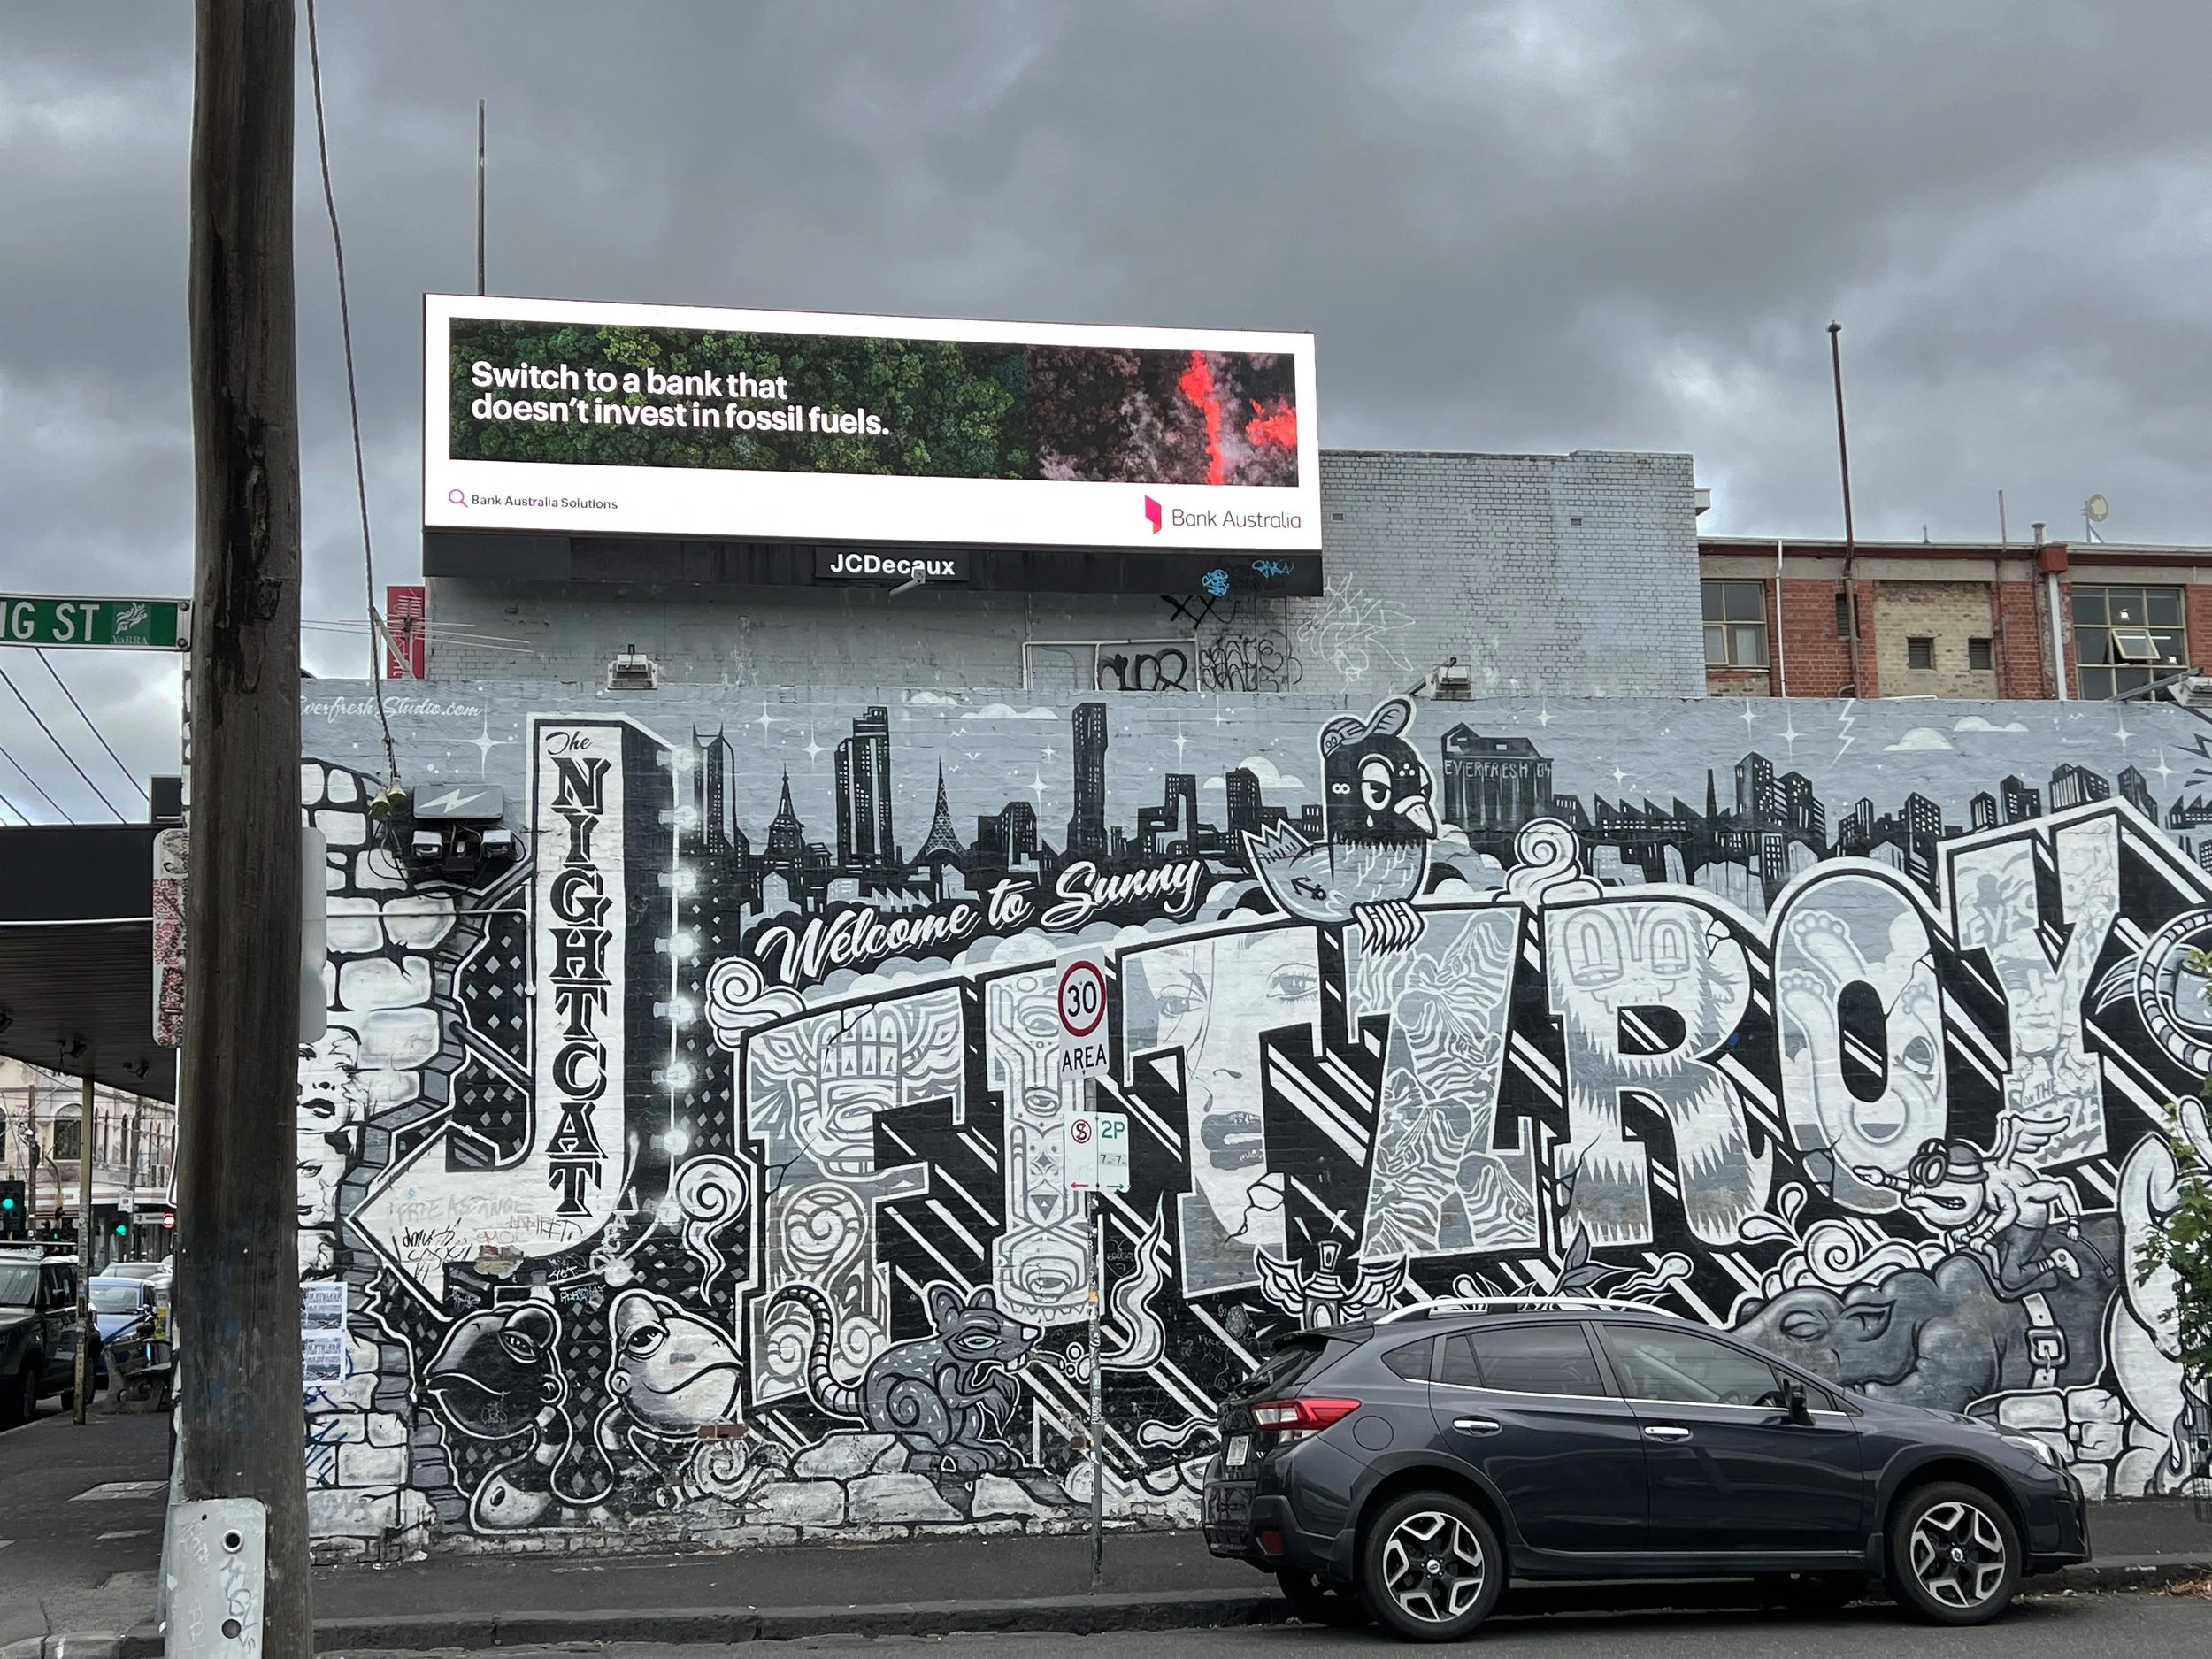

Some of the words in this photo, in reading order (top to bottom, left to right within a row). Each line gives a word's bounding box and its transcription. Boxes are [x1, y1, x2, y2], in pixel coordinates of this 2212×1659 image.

[472, 360, 580, 390] Switch
[585, 368, 618, 393] to
[622, 373, 640, 394] a
[647, 367, 723, 397] bank
[726, 372, 788, 399] that
[472, 393, 589, 424] doesn't
[595, 398, 687, 427] invest
[693, 402, 720, 428] in
[725, 403, 803, 432] fossil
[809, 406, 890, 436] fuels.
[472, 495, 502, 506] Bank
[505, 495, 558, 508] Australia
[561, 498, 618, 510] Solutions
[1172, 509, 1217, 527] Bank
[1222, 511, 1302, 529] Australia
[830, 554, 956, 576] JCDecaux
[0, 602, 35, 640] G
[52, 603, 100, 641] ST
[545, 730, 593, 756] The
[1444, 759, 1529, 779] EVERFRESH
[755, 902, 980, 986] Welcome
[988, 878, 1034, 926] to
[1041, 859, 1203, 929] Sunny
[1067, 980, 1097, 1017] 30
[1062, 1043, 1107, 1072] AREA
[741, 810, 2121, 1409] FITZROY
[1101, 1119, 1125, 1139] 2P
